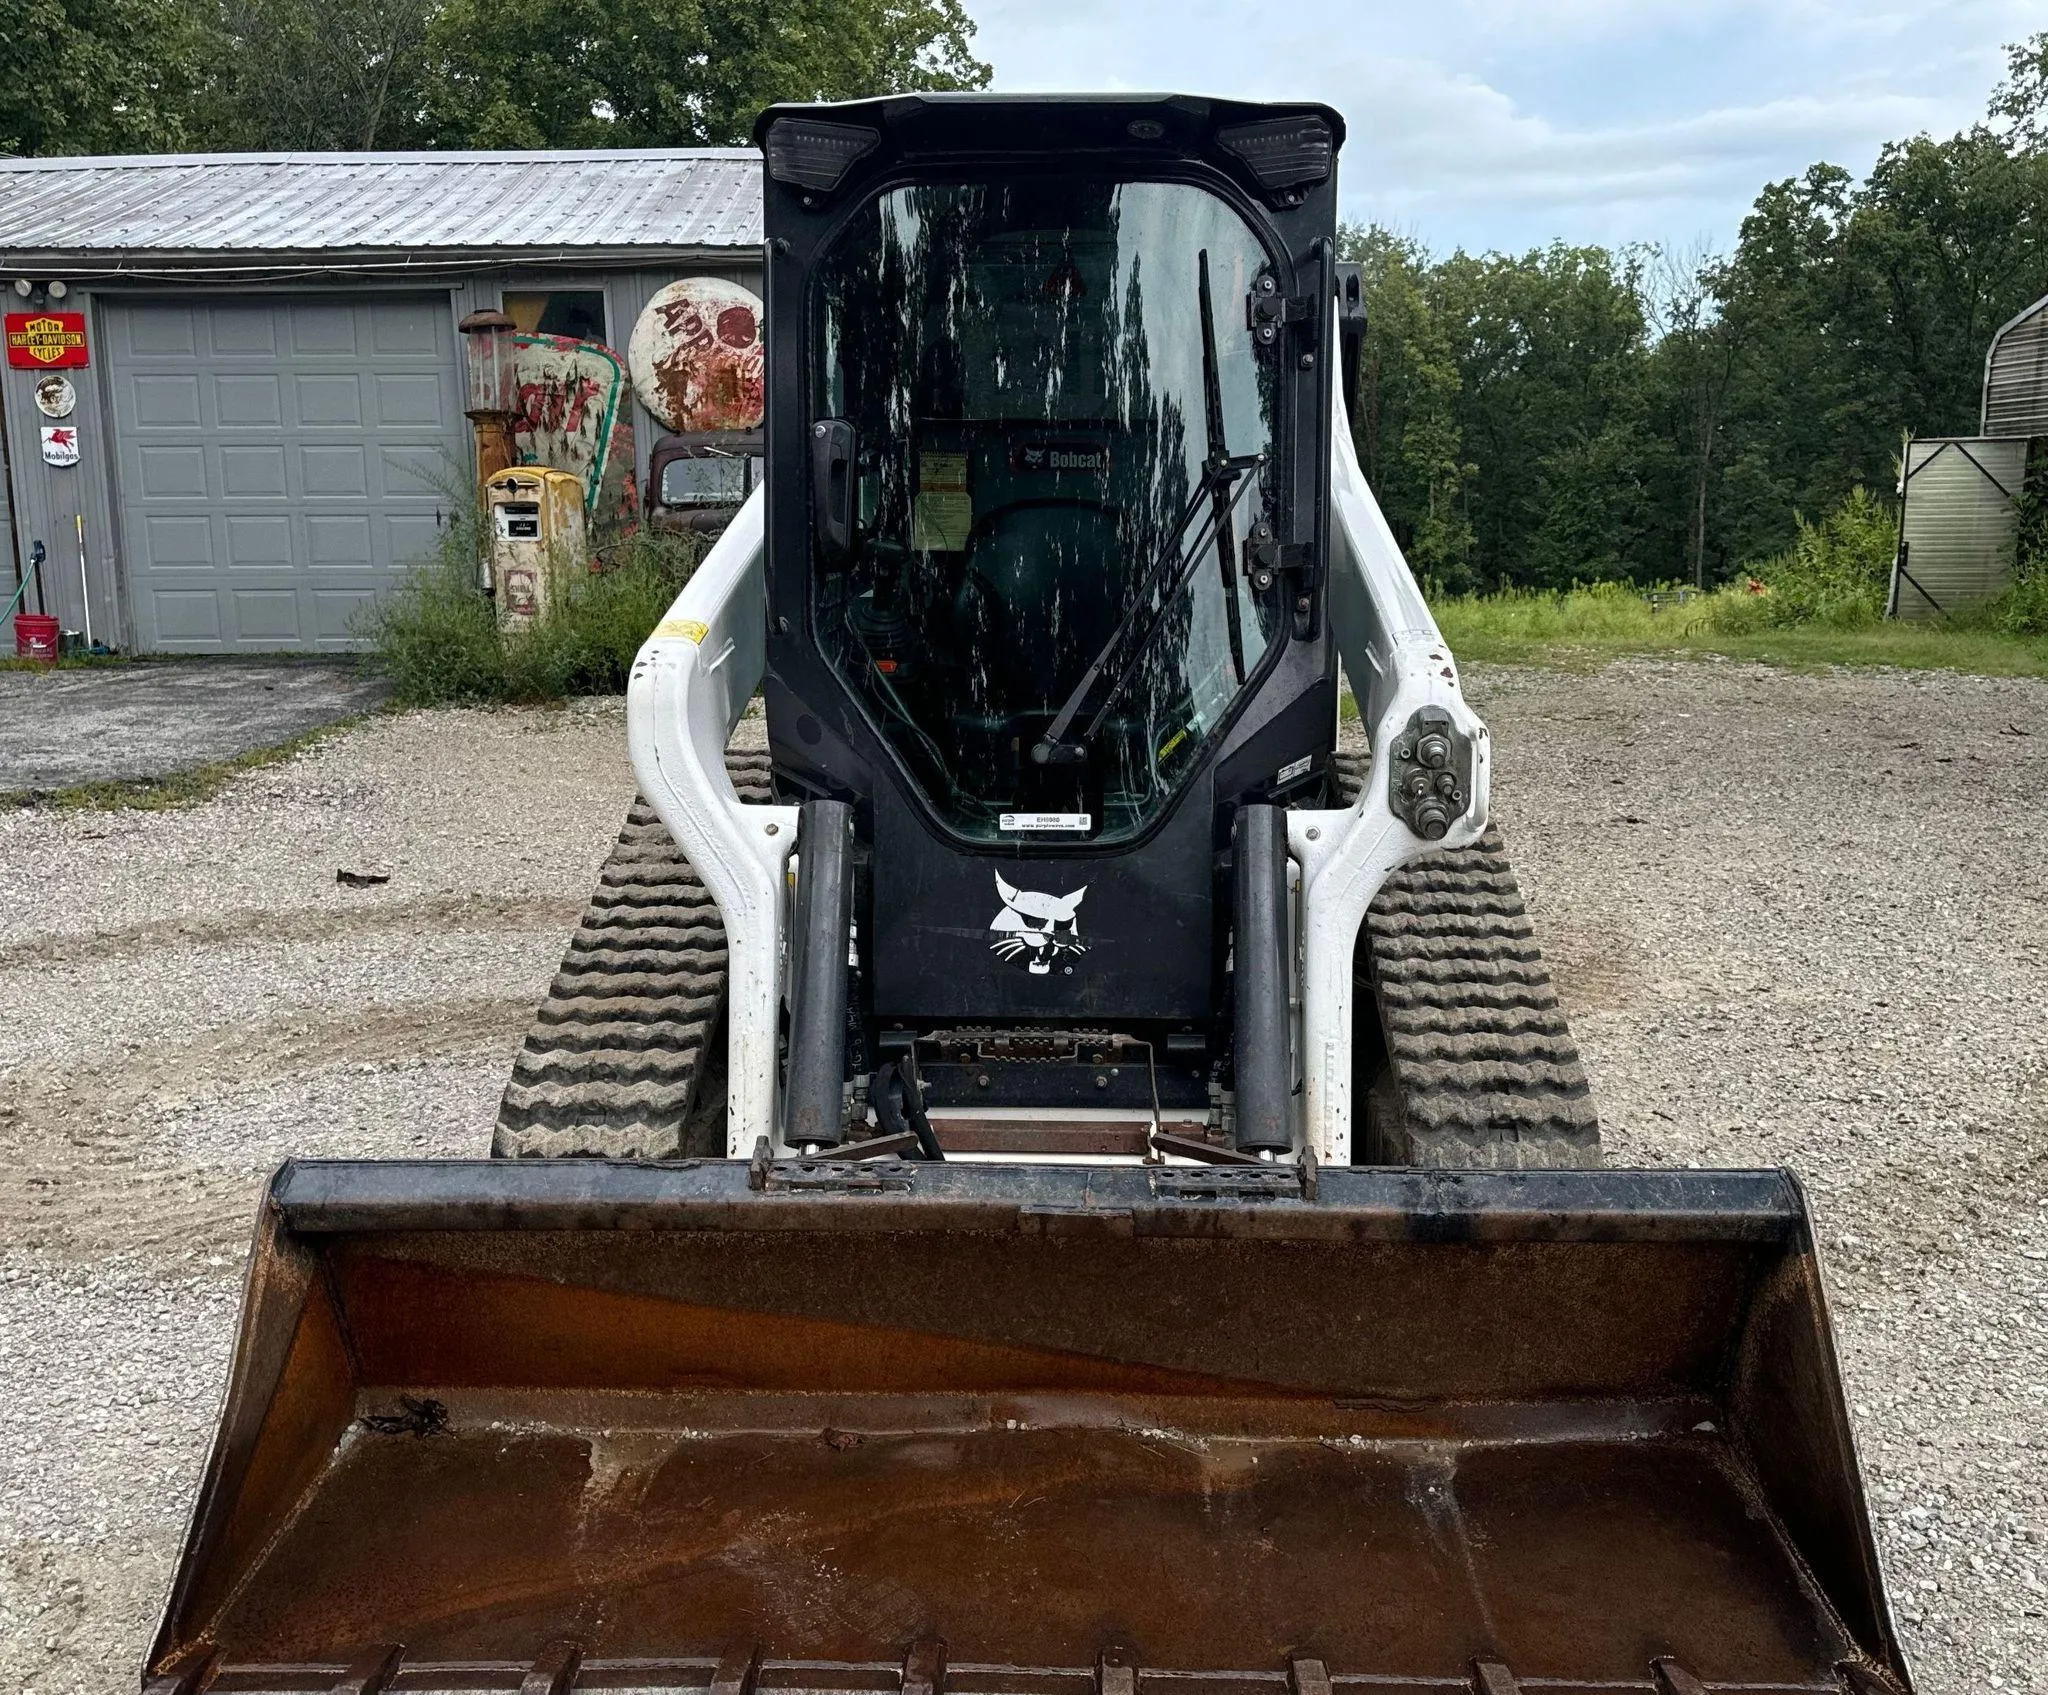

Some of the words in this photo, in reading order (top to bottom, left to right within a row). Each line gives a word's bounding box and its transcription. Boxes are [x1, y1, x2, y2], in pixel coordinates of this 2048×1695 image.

[29, 319, 60, 332] MOTOR
[11, 334, 83, 346] HARLEY-DAVIDSON
[33, 347, 61, 361] CYCLES
[44, 451, 79, 462] Mobilgas
[1050, 451, 1102, 468] Bobcat
